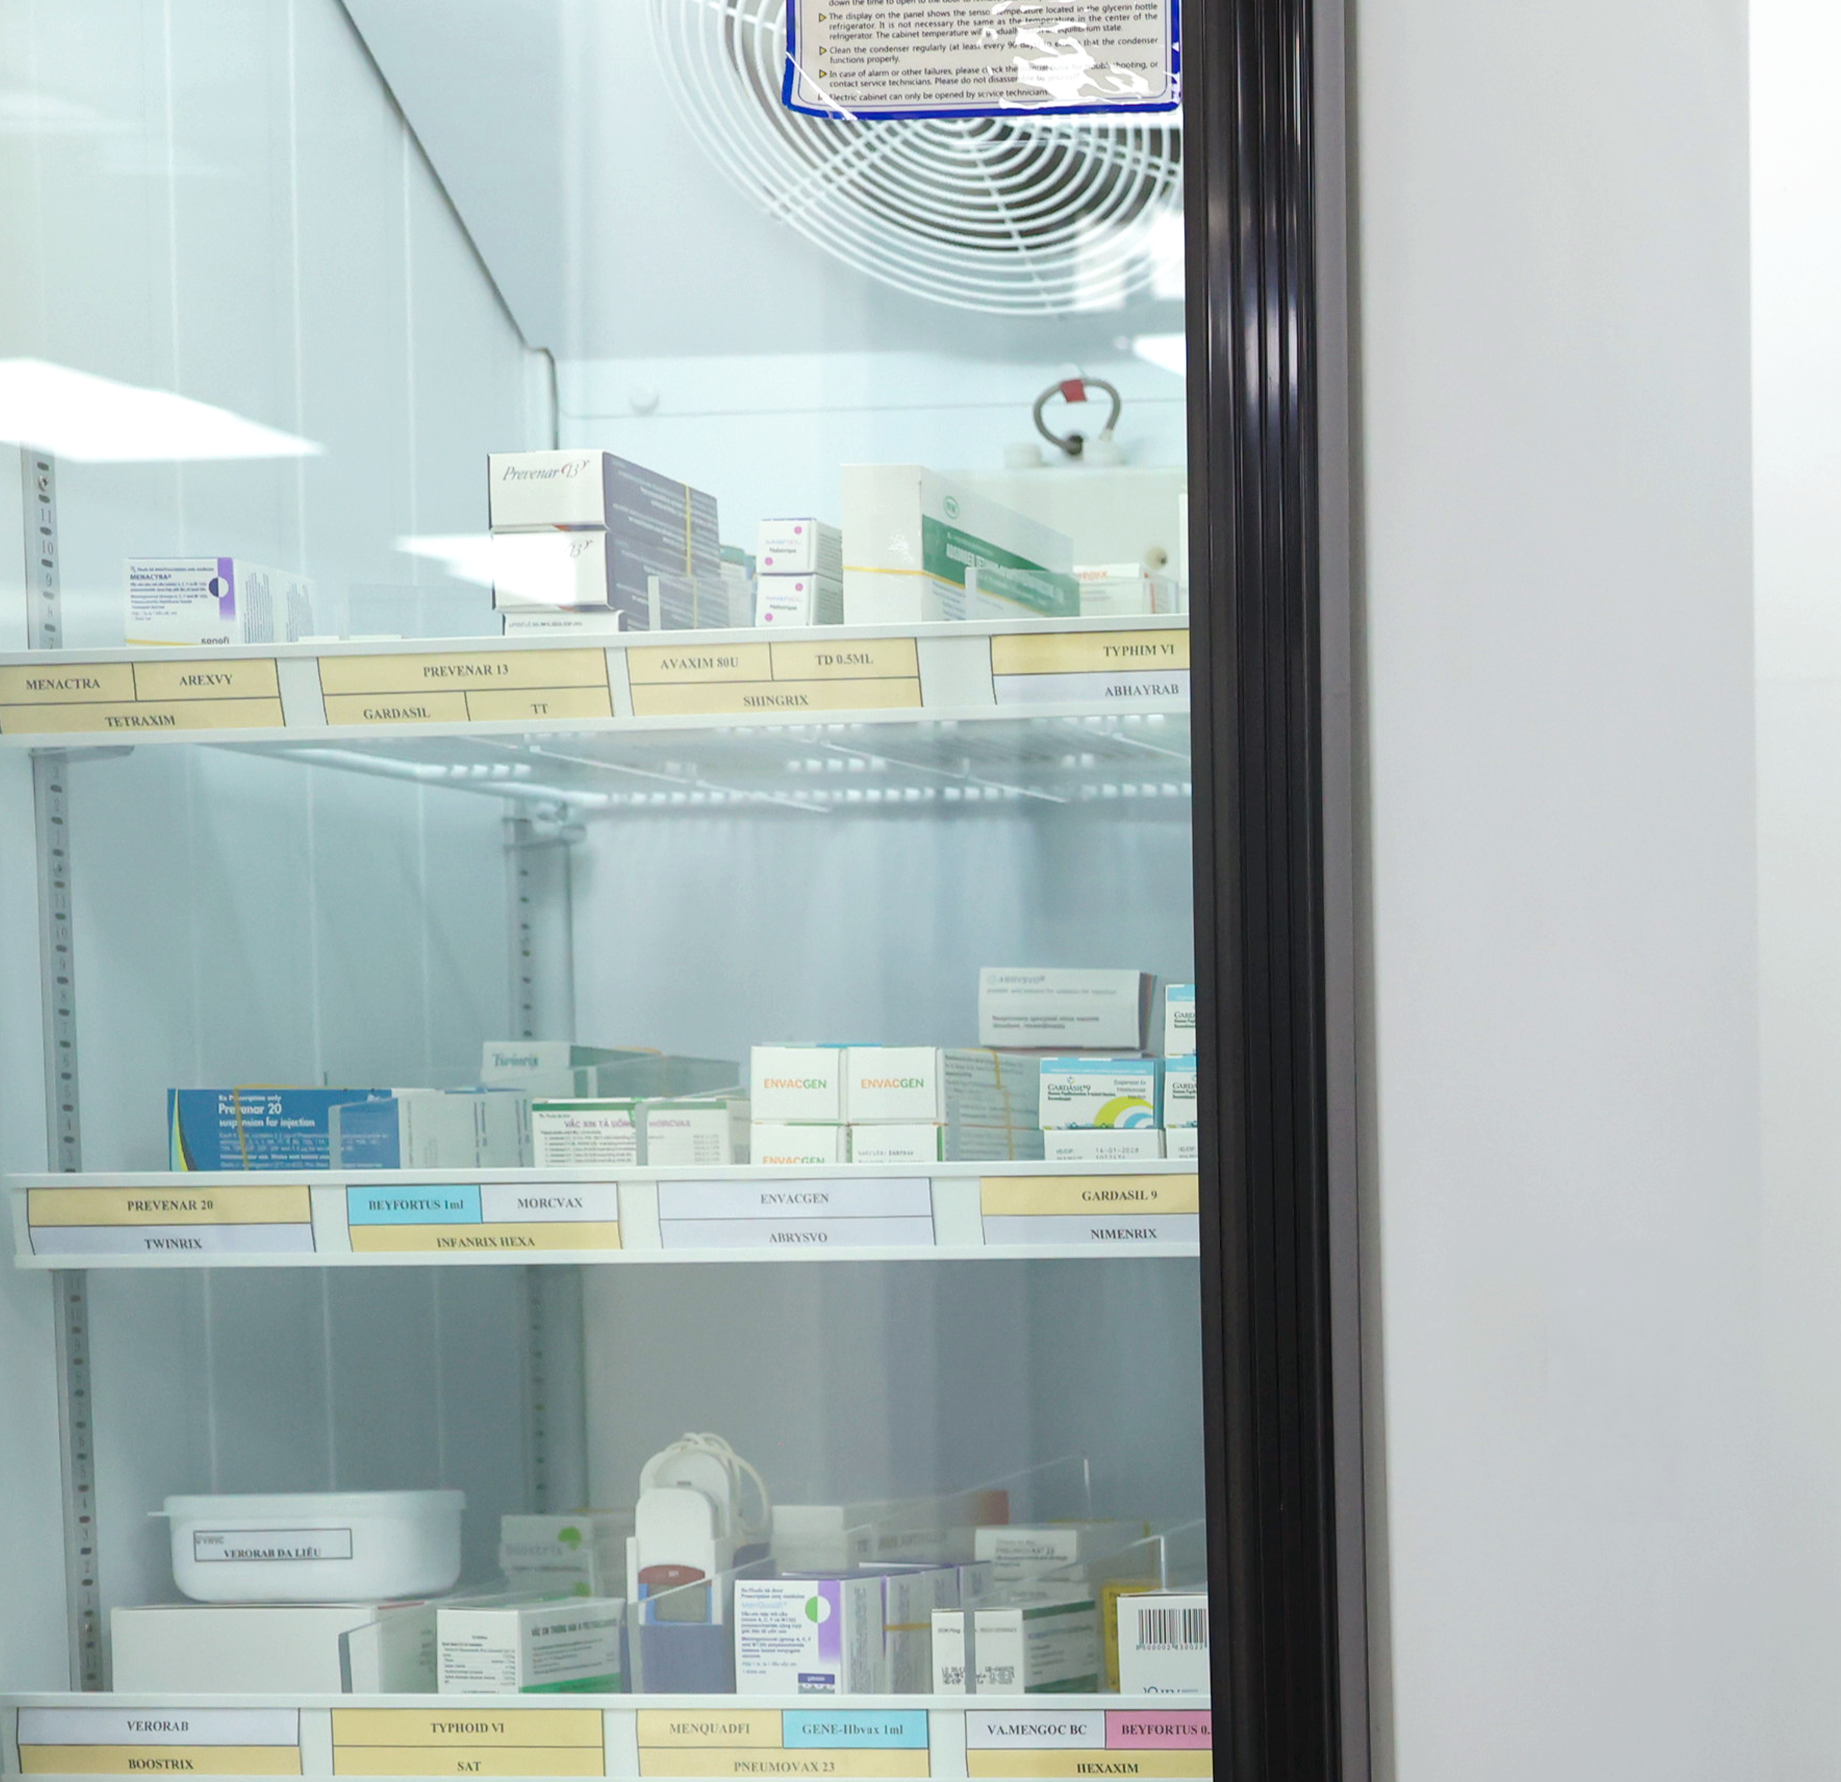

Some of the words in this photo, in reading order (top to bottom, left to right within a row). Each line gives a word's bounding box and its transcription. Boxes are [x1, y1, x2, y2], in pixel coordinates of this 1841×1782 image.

[829, 46, 852, 54] Clean
[853, 45, 867, 54] the
[869, 45, 910, 53] condenser
[912, 43, 947, 53] regularly
[502, 465, 560, 482] Prevenar
[1102, 644, 1157, 657] TYPHIM
[1160, 643, 1175, 655] VI
[660, 657, 714, 670] AVAXIM
[716, 656, 739, 668] 80U
[816, 654, 834, 666] TD
[835, 653, 874, 665] 0.5ML
[423, 664, 493, 678] PREVENAR
[496, 663, 509, 675] 13
[25, 678, 101, 691] MENACTRA
[179, 673, 233, 687] AREXVY
[1104, 683, 1180, 697] ABHAYRAB
[742, 694, 809, 707] SHINGRIX
[362, 707, 431, 720] GARDASIL
[530, 703, 548, 715] TT
[104, 714, 176, 728] TETRAXIM
[763, 1078, 828, 1090] ENVACGEN
[860, 1077, 925, 1089] ENVACGEN
[267, 1103, 283, 1115] 20
[760, 1192, 829, 1205] ENVACGEN
[1081, 1189, 1149, 1202] GARDASIL
[1150, 1190, 1158, 1200] 9
[127, 1199, 198, 1212] PREVENAR
[201, 1199, 214, 1211] 20
[368, 1199, 441, 1211] BEYFORTUS
[444, 1199, 464, 1210] 1ml
[517, 1197, 583, 1209] MORCVAX
[769, 1232, 828, 1243] ABRYSVO
[1090, 1228, 1158, 1240] NIMENRIX
[143, 1238, 203, 1250] TWINRIX
[436, 1236, 498, 1249] INFANRIX
[499, 1236, 536, 1247] HEXA
[126, 1720, 189, 1732] VERORAB
[431, 1722, 489, 1734] TYPHOID
[491, 1722, 505, 1734] VI
[669, 1722, 750, 1736] MENQUADFI
[801, 1723, 880, 1735] GENE-Hbvax
[884, 1723, 904, 1736] 1ml
[987, 1724, 1067, 1736] VA.MENGOC
[1069, 1724, 1088, 1736] BC
[1121, 1724, 1198, 1736] BEYFORTUS
[1200, 1724, 1212, 1736] 0.
[127, 1758, 194, 1770] BOOSTRIX
[457, 1761, 482, 1772] SAT
[733, 1761, 819, 1773] PNEUMOVAX
[822, 1761, 835, 1773] 23
[1076, 1763, 1139, 1774] HEXAXIM
